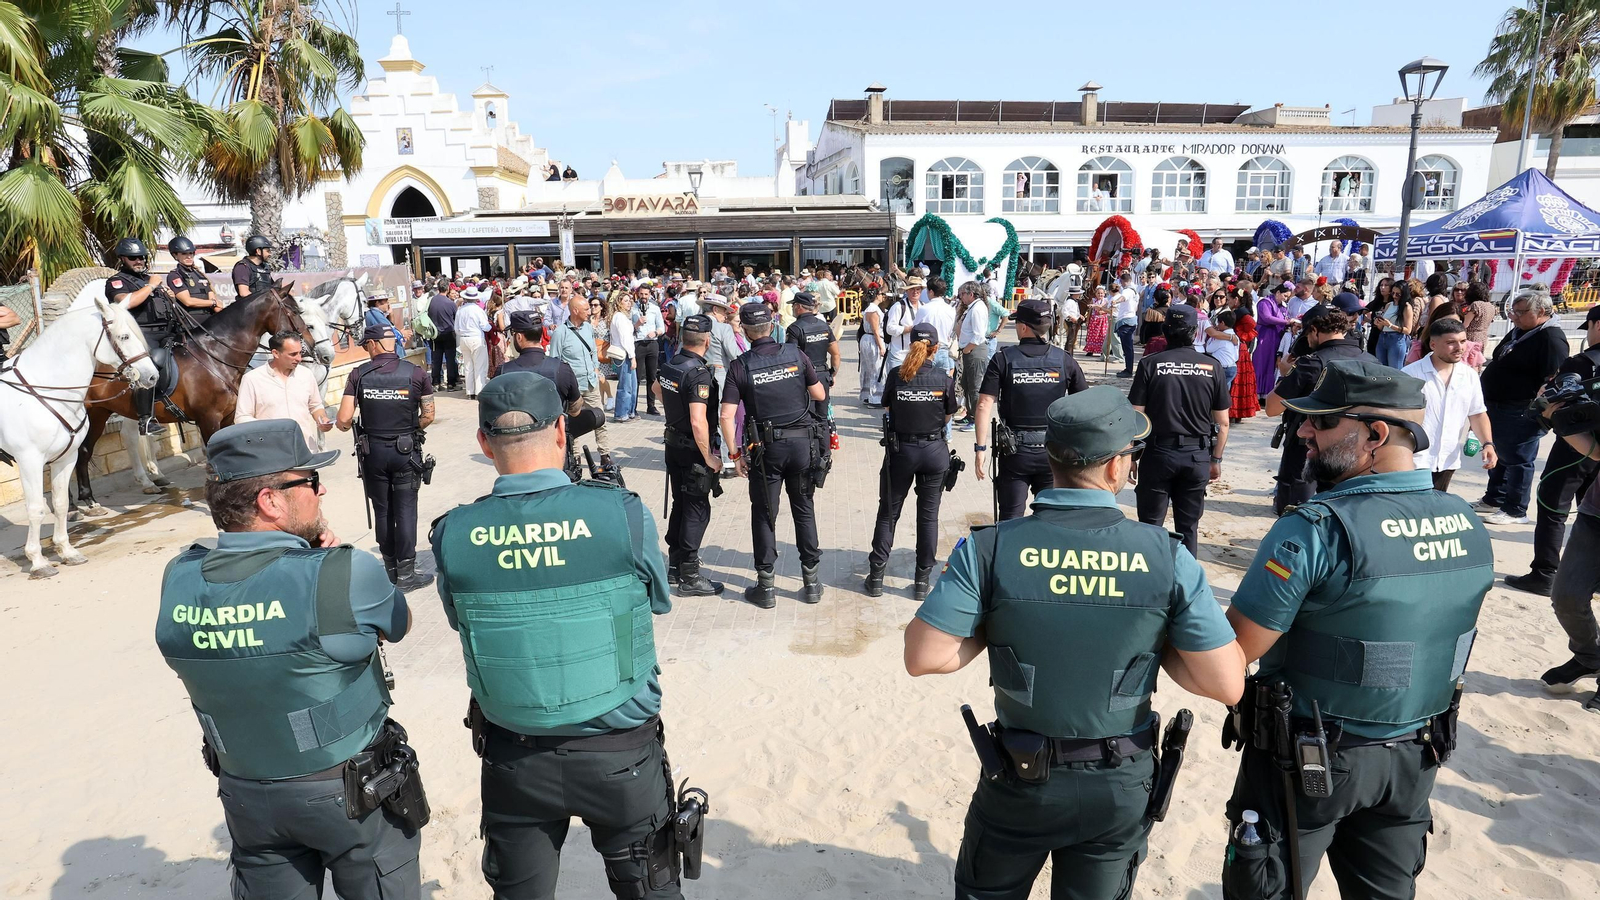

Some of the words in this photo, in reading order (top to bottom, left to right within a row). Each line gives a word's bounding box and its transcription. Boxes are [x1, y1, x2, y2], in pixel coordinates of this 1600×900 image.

[1081, 144, 1175, 154] RESTAURANTE
[1182, 144, 1235, 155] MIRADOR
[1241, 143, 1286, 155] DOÑANA
[603, 197, 698, 211] BOTAVARA
[438, 226, 466, 234] HELADERÍA
[471, 225, 499, 234] CAFETERÍA
[752, 367, 790, 380] POLICIA
[1156, 361, 1201, 369] POLICIA
[1157, 368, 1213, 378] NACIONAL
[753, 371, 800, 386] NACIONAL
[469, 518, 592, 547] GUARDIA
[1380, 512, 1474, 538] GUARDIA
[497, 546, 566, 570] CIVIL
[1019, 546, 1150, 573] GUARDIA
[1413, 537, 1468, 562] CIVIL
[1048, 574, 1125, 598] CIVIL
[172, 600, 286, 627] GUARDIA
[192, 628, 264, 651] CIVIL
